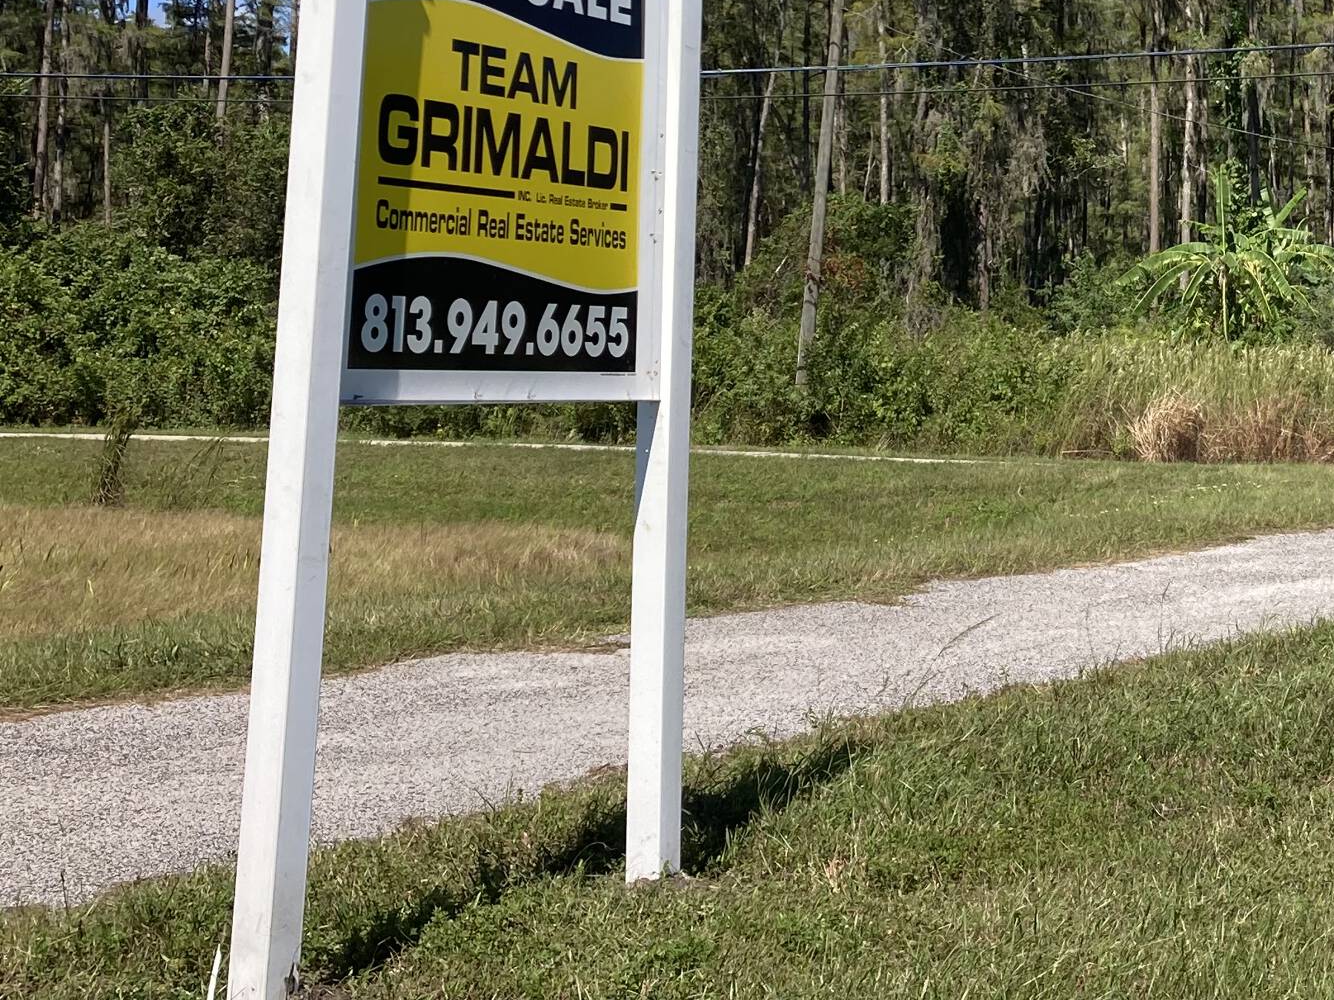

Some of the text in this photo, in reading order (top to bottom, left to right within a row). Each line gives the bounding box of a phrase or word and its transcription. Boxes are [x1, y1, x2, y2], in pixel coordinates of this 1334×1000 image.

[452, 38, 578, 110] TEAM
[377, 93, 629, 192] GRIMALDI
[375, 199, 627, 250] Commercial Real Estate Services
[549, 194, 562, 206] Real
[564, 196, 586, 209] Estate
[587, 198, 609, 211] Broker
[360, 293, 629, 359] 813.949.6655
